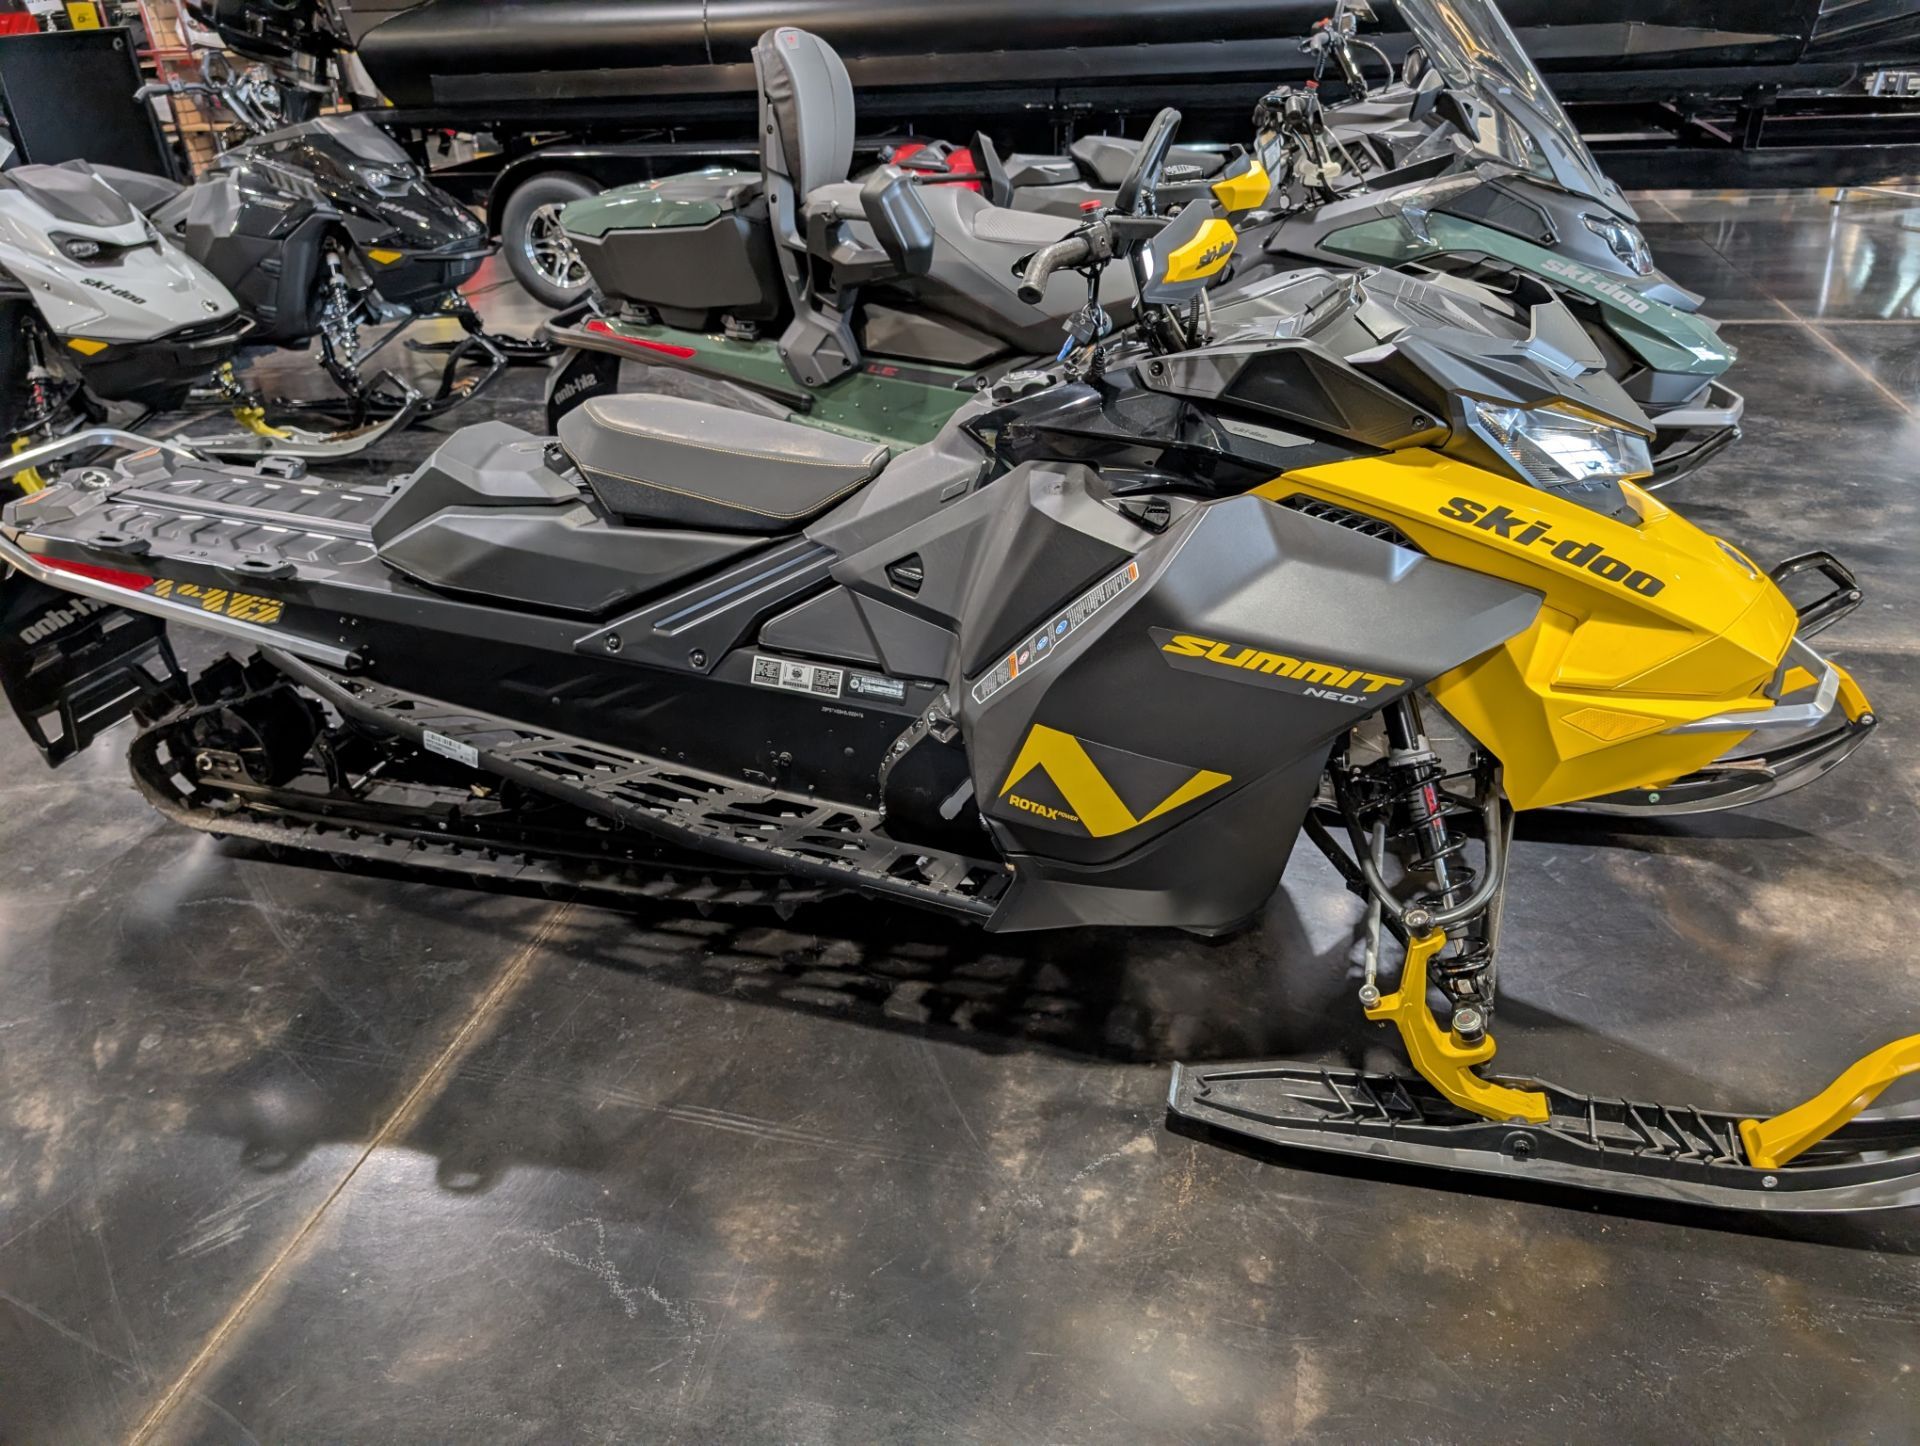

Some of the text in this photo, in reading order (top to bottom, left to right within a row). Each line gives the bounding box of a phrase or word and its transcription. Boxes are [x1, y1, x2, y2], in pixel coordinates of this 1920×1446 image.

[80, 277, 147, 305] ski-doo
[1541, 259, 1649, 314] ski-doo
[1438, 497, 1666, 598] ski-doo
[1162, 634, 1406, 693] SUMMIT
[1009, 794, 1058, 820] ROTAX
